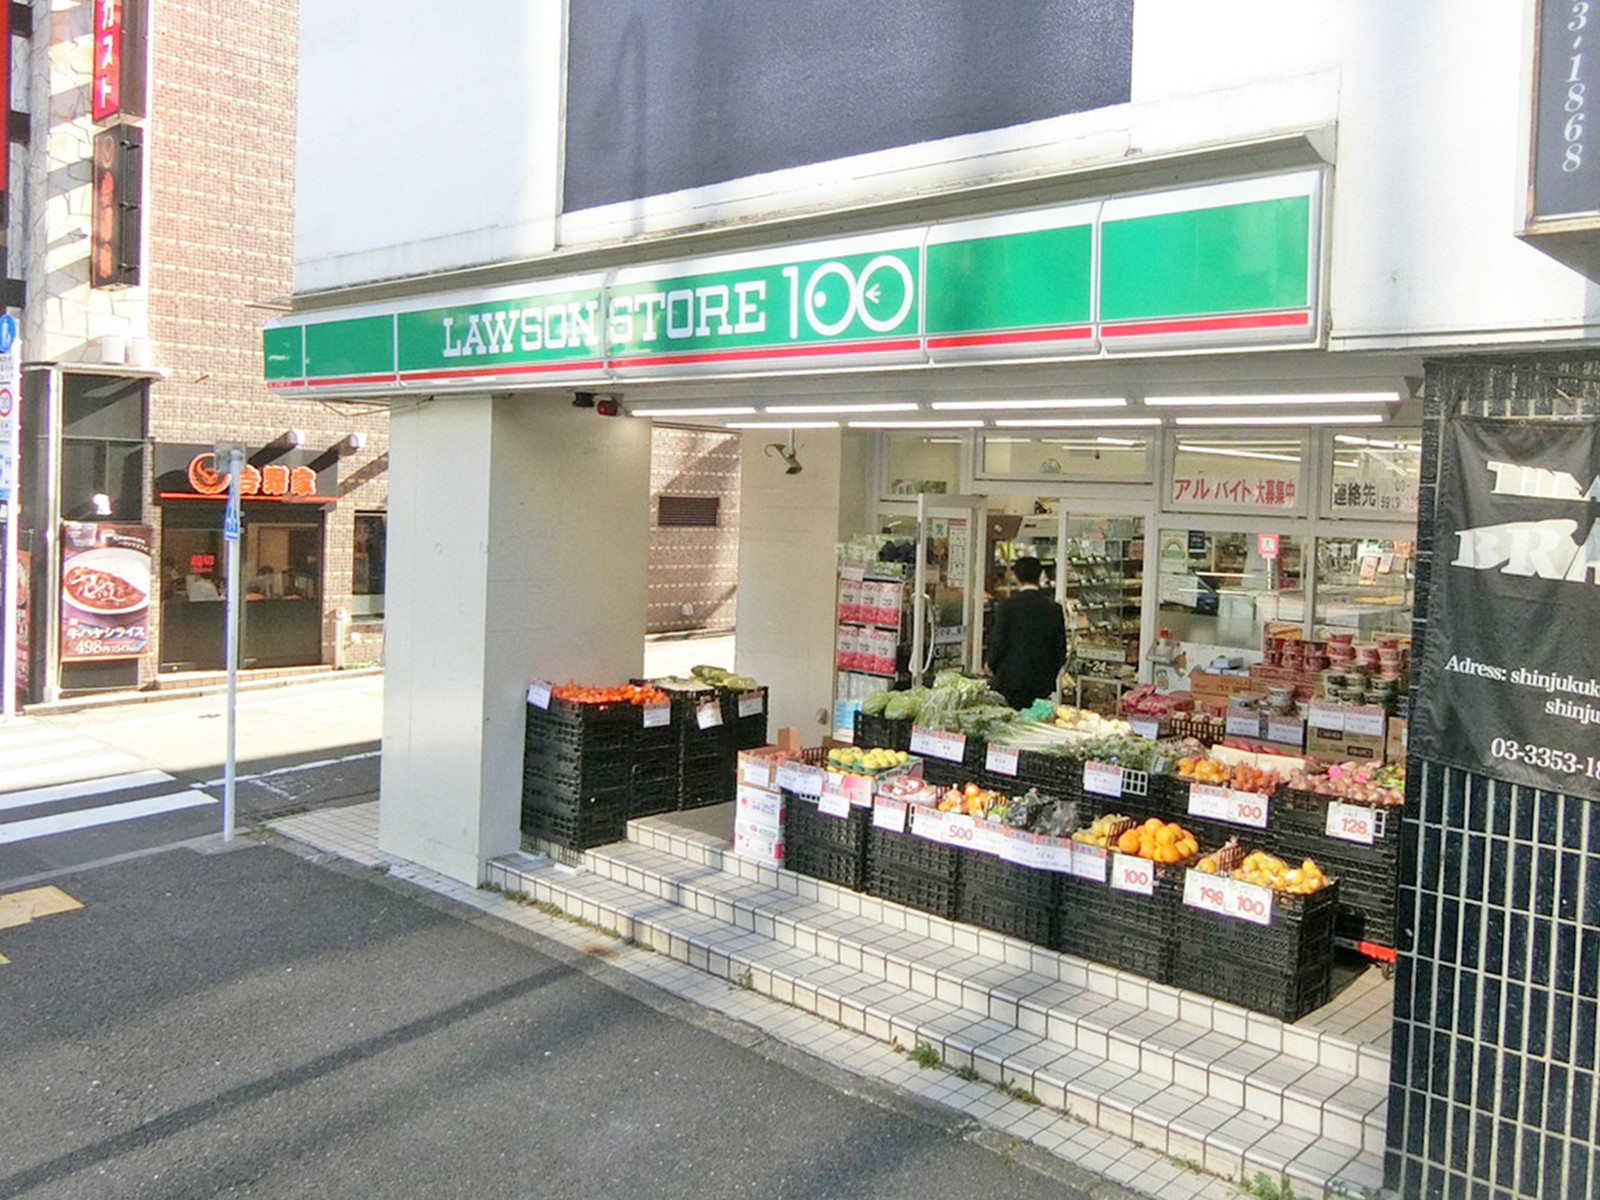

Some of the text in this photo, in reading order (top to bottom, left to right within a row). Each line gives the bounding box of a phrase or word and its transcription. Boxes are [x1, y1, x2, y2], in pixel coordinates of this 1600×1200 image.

[443, 255, 914, 357] LAWSON STORE 100
[1334, 482, 1377, 506] 連絡先
[1444, 654, 1508, 681] Adress:
[1237, 803, 1262, 820] 100
[948, 826, 973, 841] 500
[1341, 817, 1368, 835] 128
[1123, 869, 1149, 886] 100
[1237, 895, 1265, 916] 100
